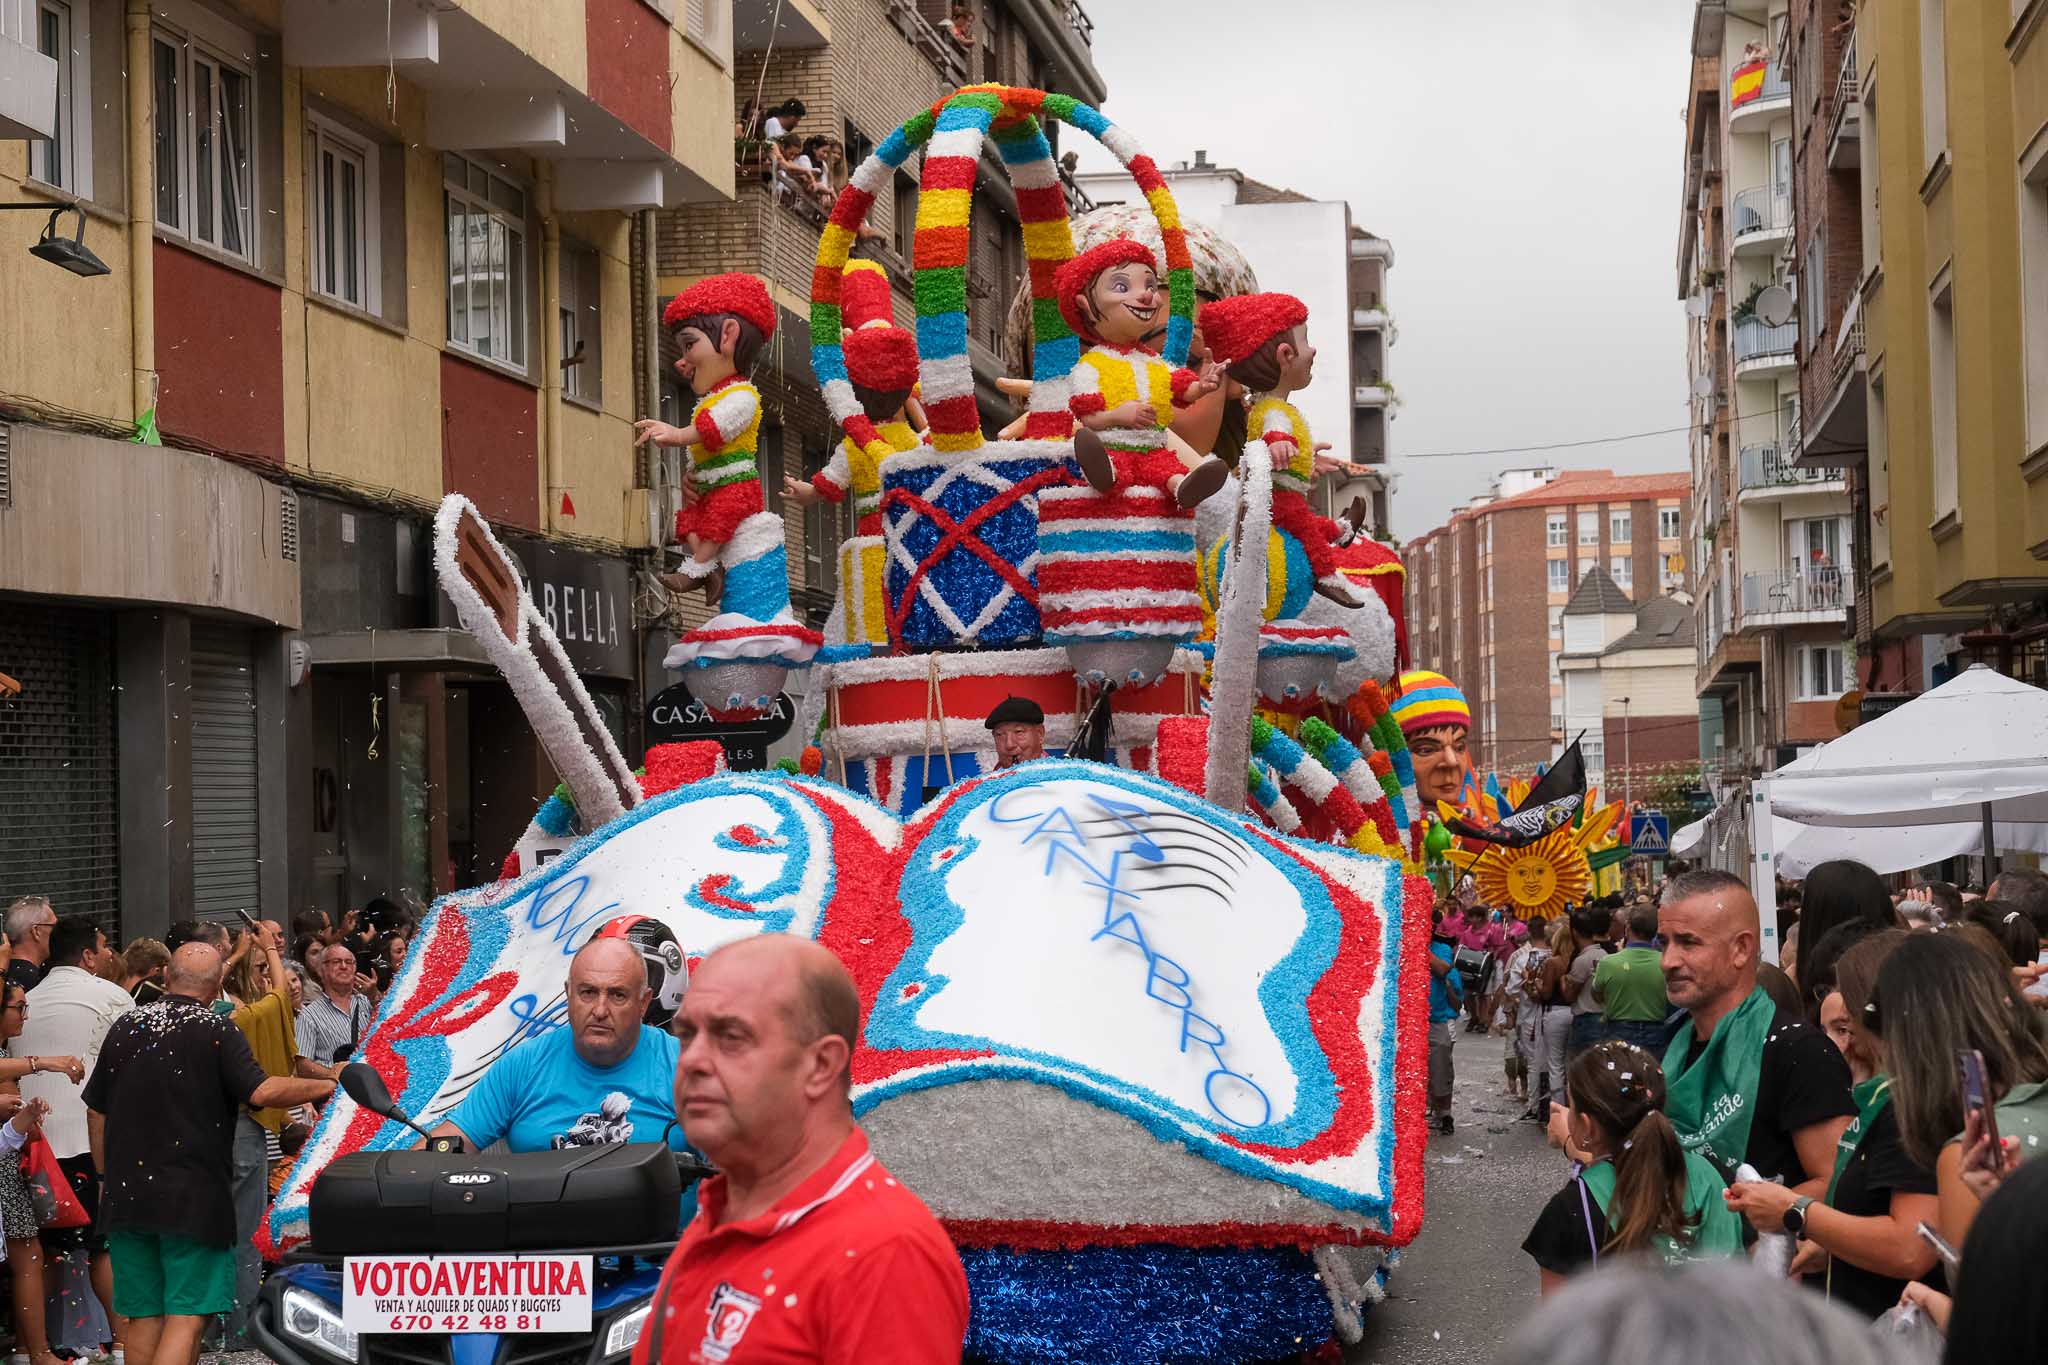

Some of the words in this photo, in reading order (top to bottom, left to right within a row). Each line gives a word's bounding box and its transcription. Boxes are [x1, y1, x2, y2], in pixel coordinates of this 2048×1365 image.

[449, 1174, 491, 1184] SHAD
[350, 1261, 587, 1297] VOTOAVENTURA
[375, 1300, 405, 1313] VENTA
[408, 1300, 414, 1313] Y
[415, 1300, 460, 1314] ALQUILER
[463, 1300, 475, 1313] DE
[477, 1300, 509, 1313] QUADS
[512, 1299, 519, 1312] Y
[520, 1299, 561, 1312] BUGGYES
[390, 1315, 433, 1330] 670
[441, 1315, 469, 1330] 42
[479, 1315, 507, 1330] 48
[517, 1315, 542, 1329] 81
